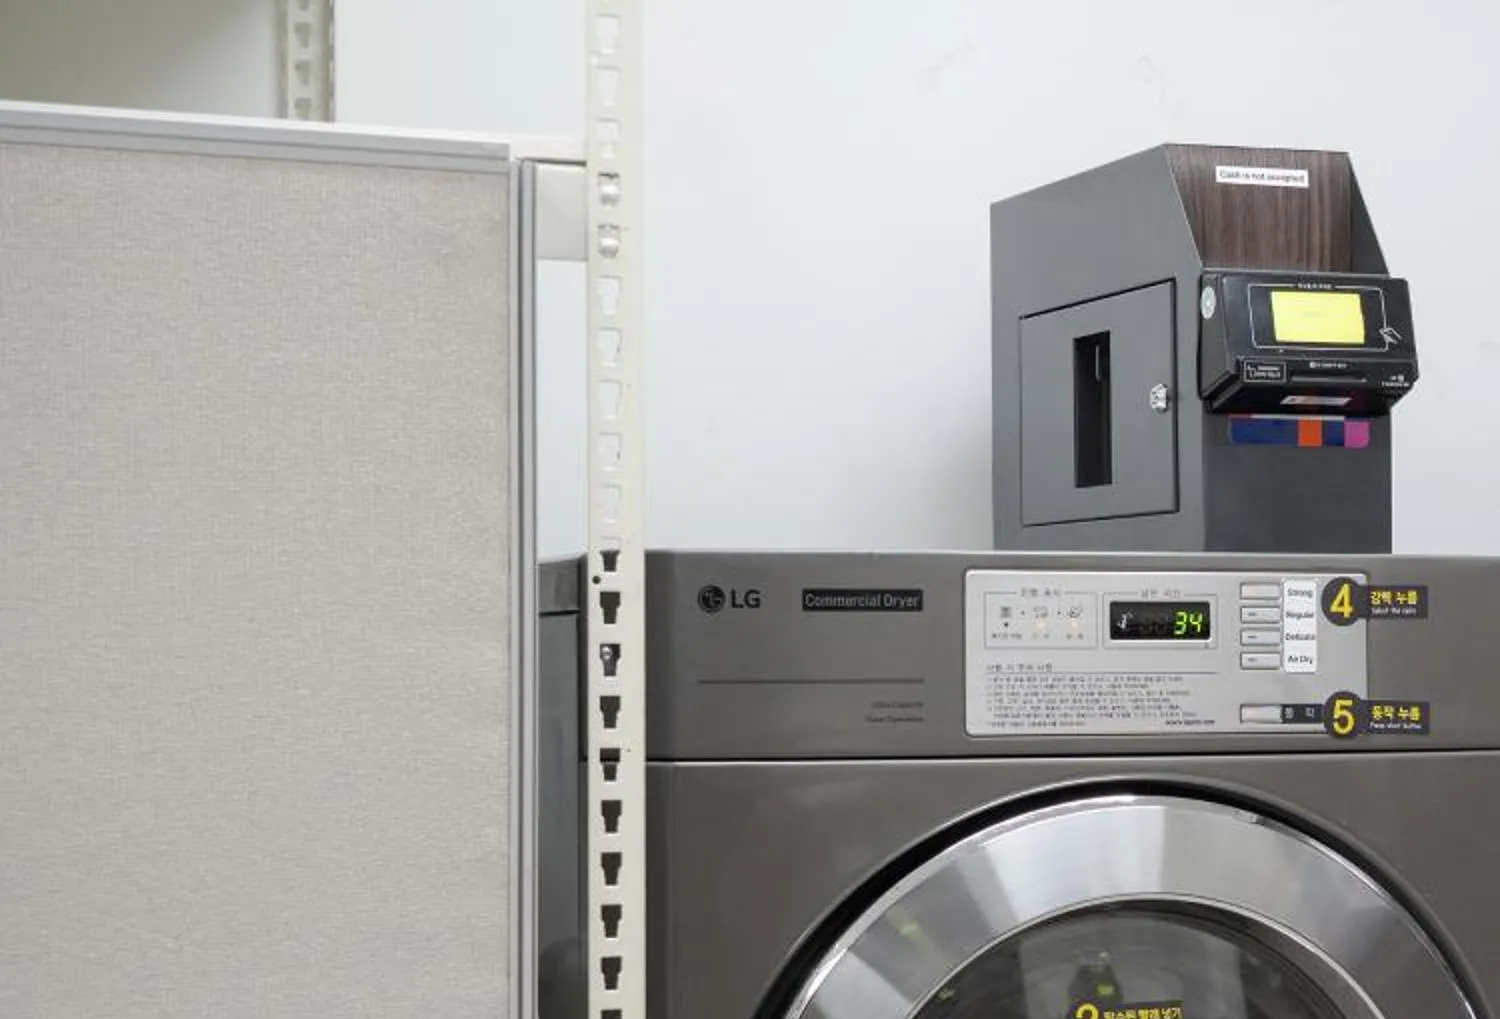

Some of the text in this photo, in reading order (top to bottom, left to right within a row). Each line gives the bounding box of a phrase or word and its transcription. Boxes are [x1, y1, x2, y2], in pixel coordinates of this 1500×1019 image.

[731, 588, 762, 609] LG
[804, 592, 921, 610] Commercial Dryer
[1286, 588, 1313, 598] Strong
[1329, 582, 1353, 618] 4
[1173, 611, 1203, 635] 34
[1332, 699, 1355, 736] 5
